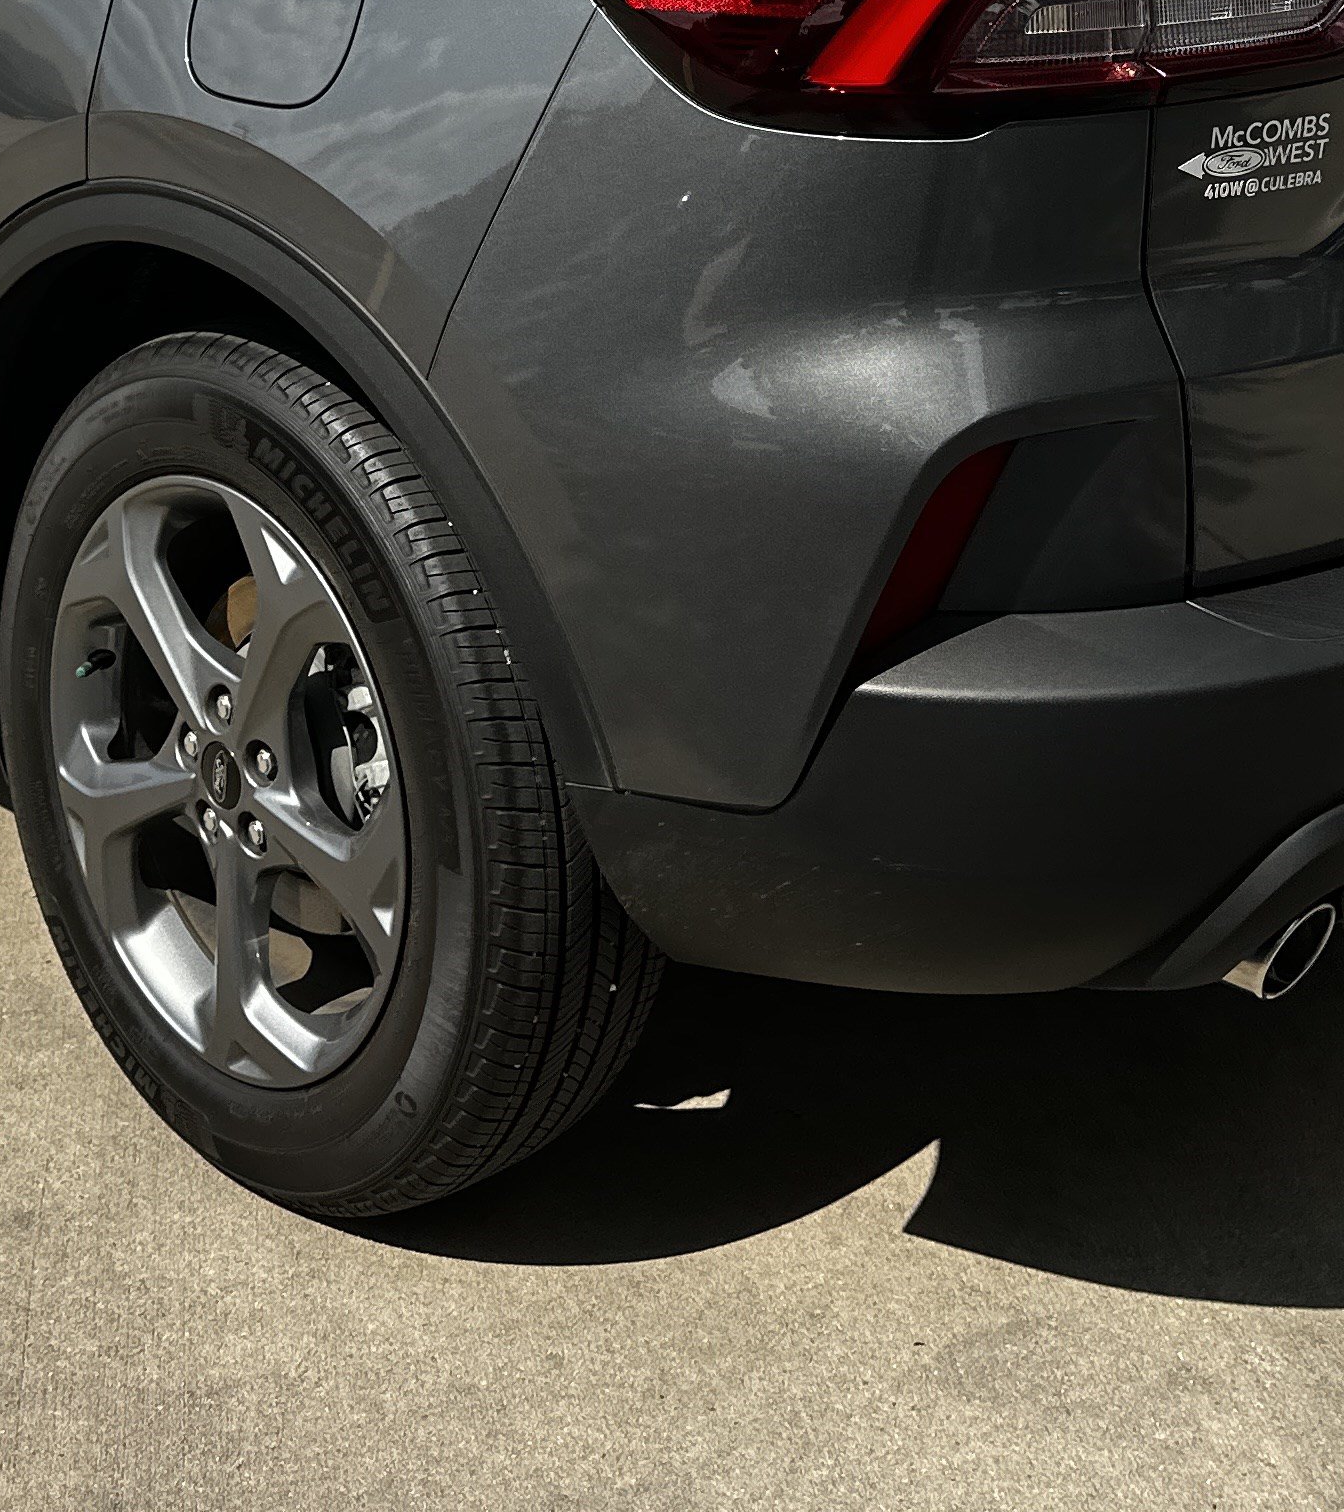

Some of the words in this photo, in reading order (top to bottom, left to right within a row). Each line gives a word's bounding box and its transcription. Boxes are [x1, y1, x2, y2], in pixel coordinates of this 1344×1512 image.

[1210, 112, 1331, 149] McCOMBS
[1217, 153, 1252, 171] Ford
[1265, 138, 1330, 167] WEST
[256, 438, 392, 612] MICHELIN
